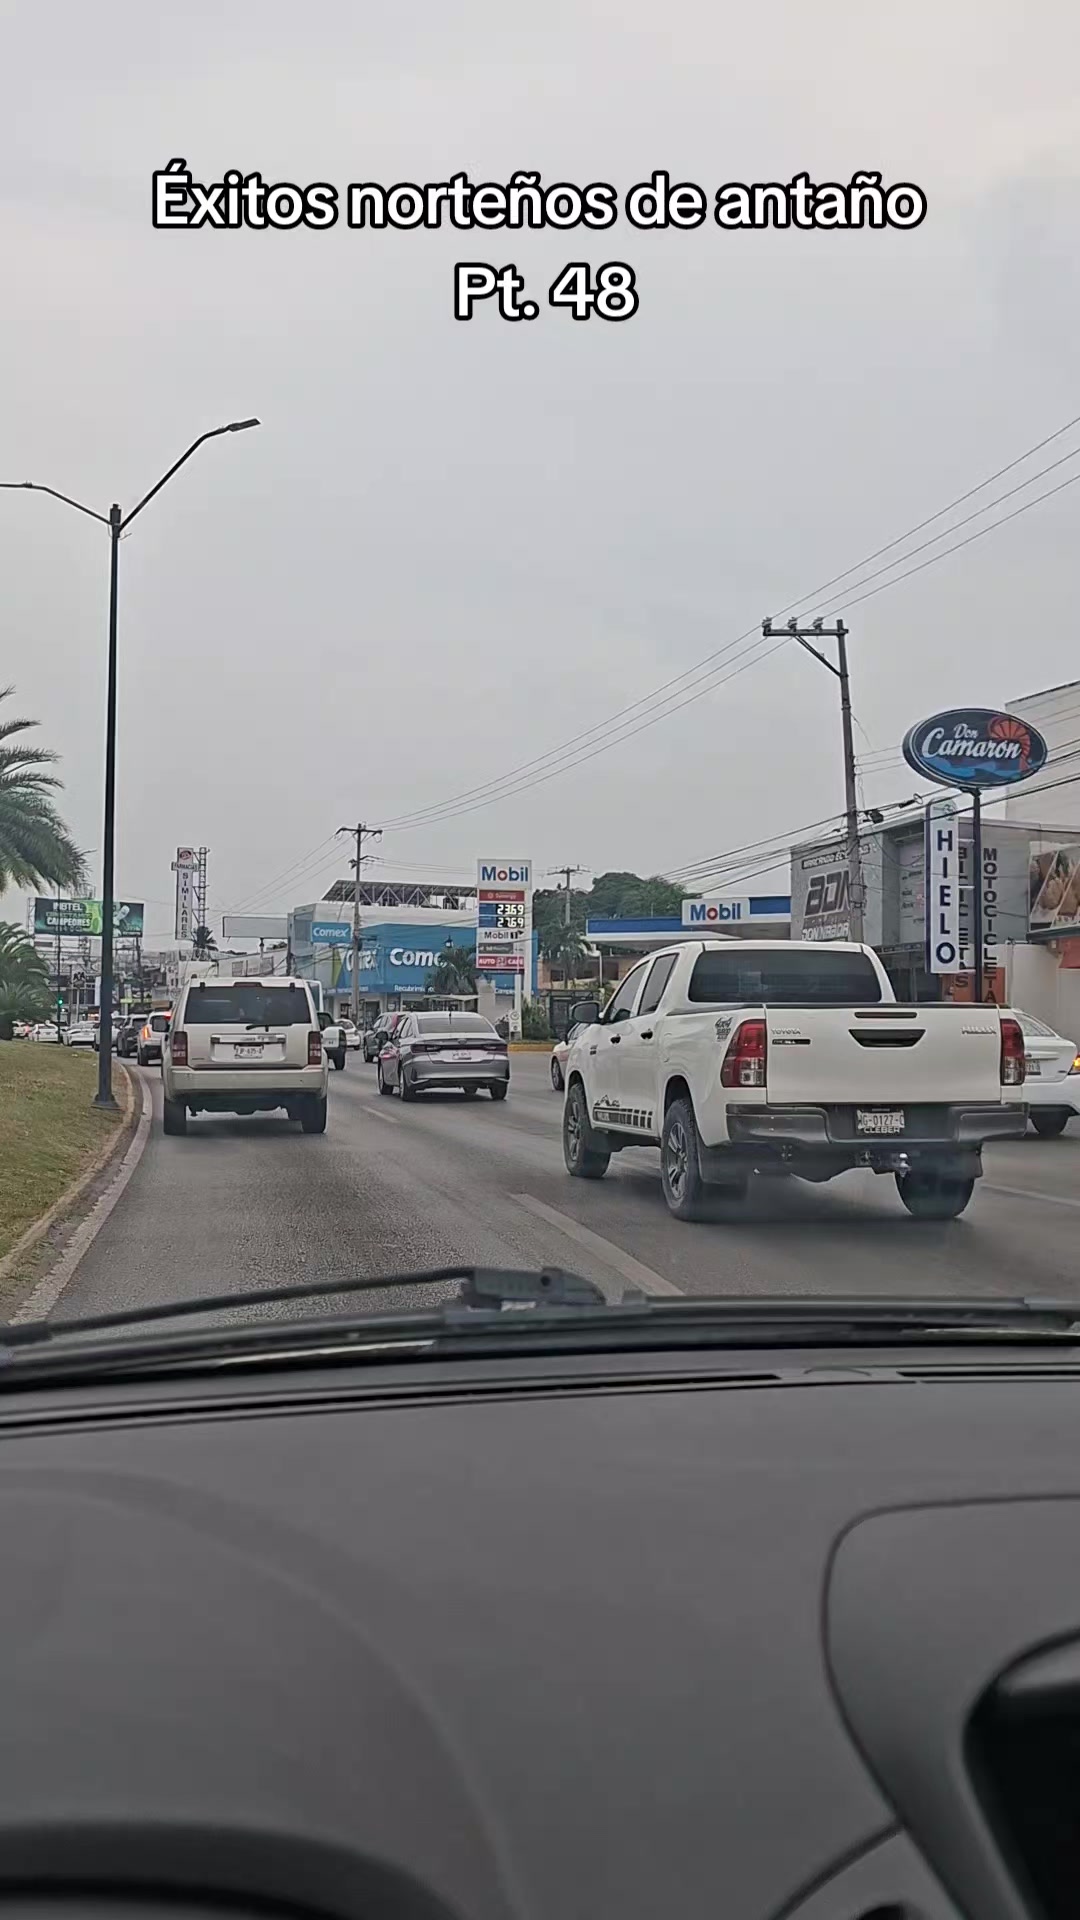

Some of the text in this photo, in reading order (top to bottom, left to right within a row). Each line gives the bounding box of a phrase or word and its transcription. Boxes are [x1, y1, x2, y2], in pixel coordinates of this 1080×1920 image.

[953, 723, 979, 739] Don
[481, 866, 529, 882] Mobil
[935, 829, 956, 964] HIELO
[181, 872, 189, 939] SIMILARES
[690, 902, 741, 921] Mobil
[313, 926, 349, 938] Comex
[484, 931, 509, 939] Mobil
[770, 1027, 801, 1035] TOYOTA
